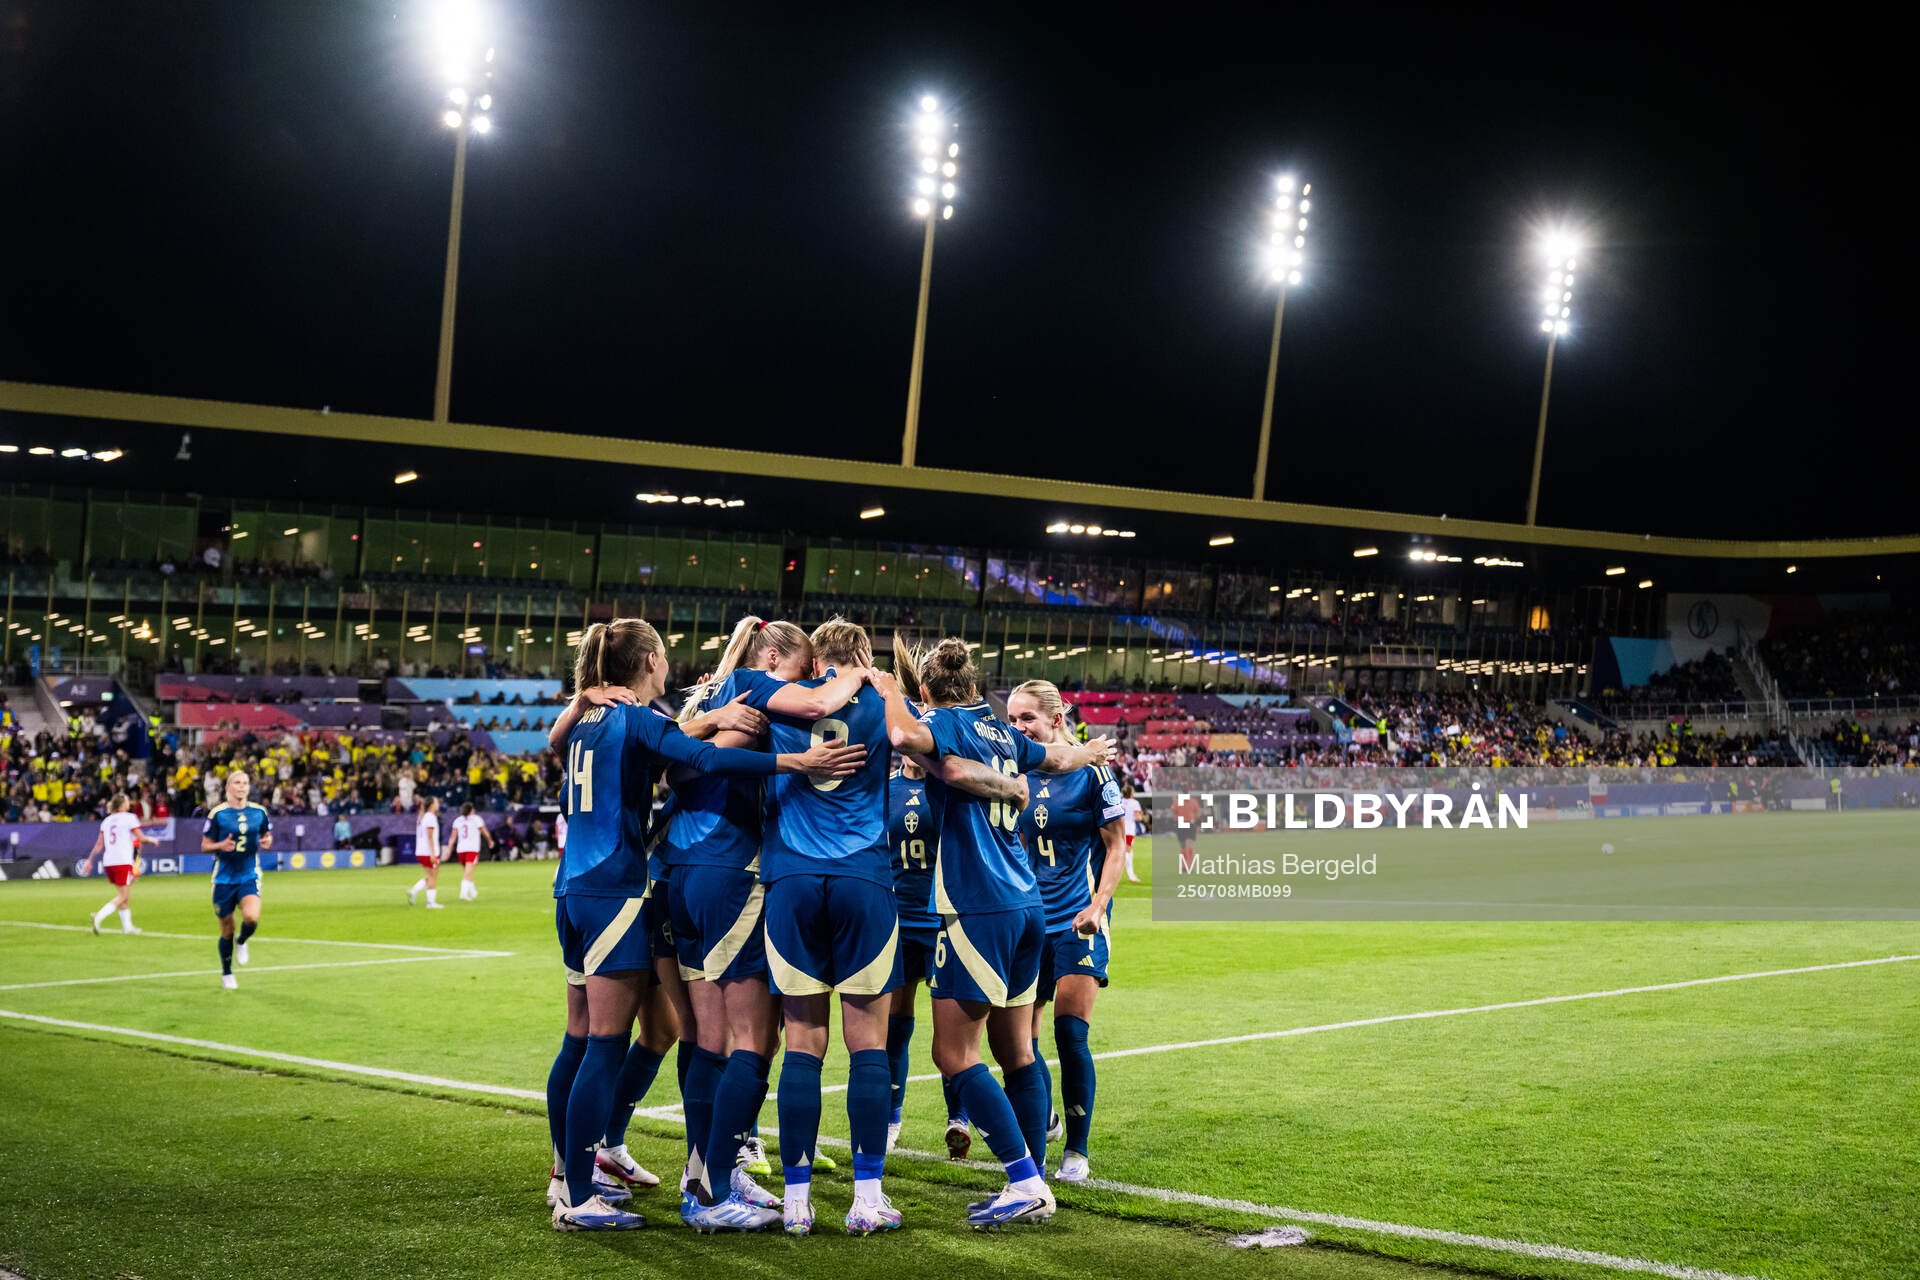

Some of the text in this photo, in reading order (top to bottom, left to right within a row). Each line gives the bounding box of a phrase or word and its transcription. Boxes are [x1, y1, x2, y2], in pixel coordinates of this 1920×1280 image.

[568, 739, 594, 816] 14
[109, 824, 117, 845] 5
[236, 835, 248, 852] 2
[462, 824, 469, 839] 3
[900, 839, 927, 869] 19
[1037, 835, 1055, 867] 4
[935, 930, 947, 968] 6
